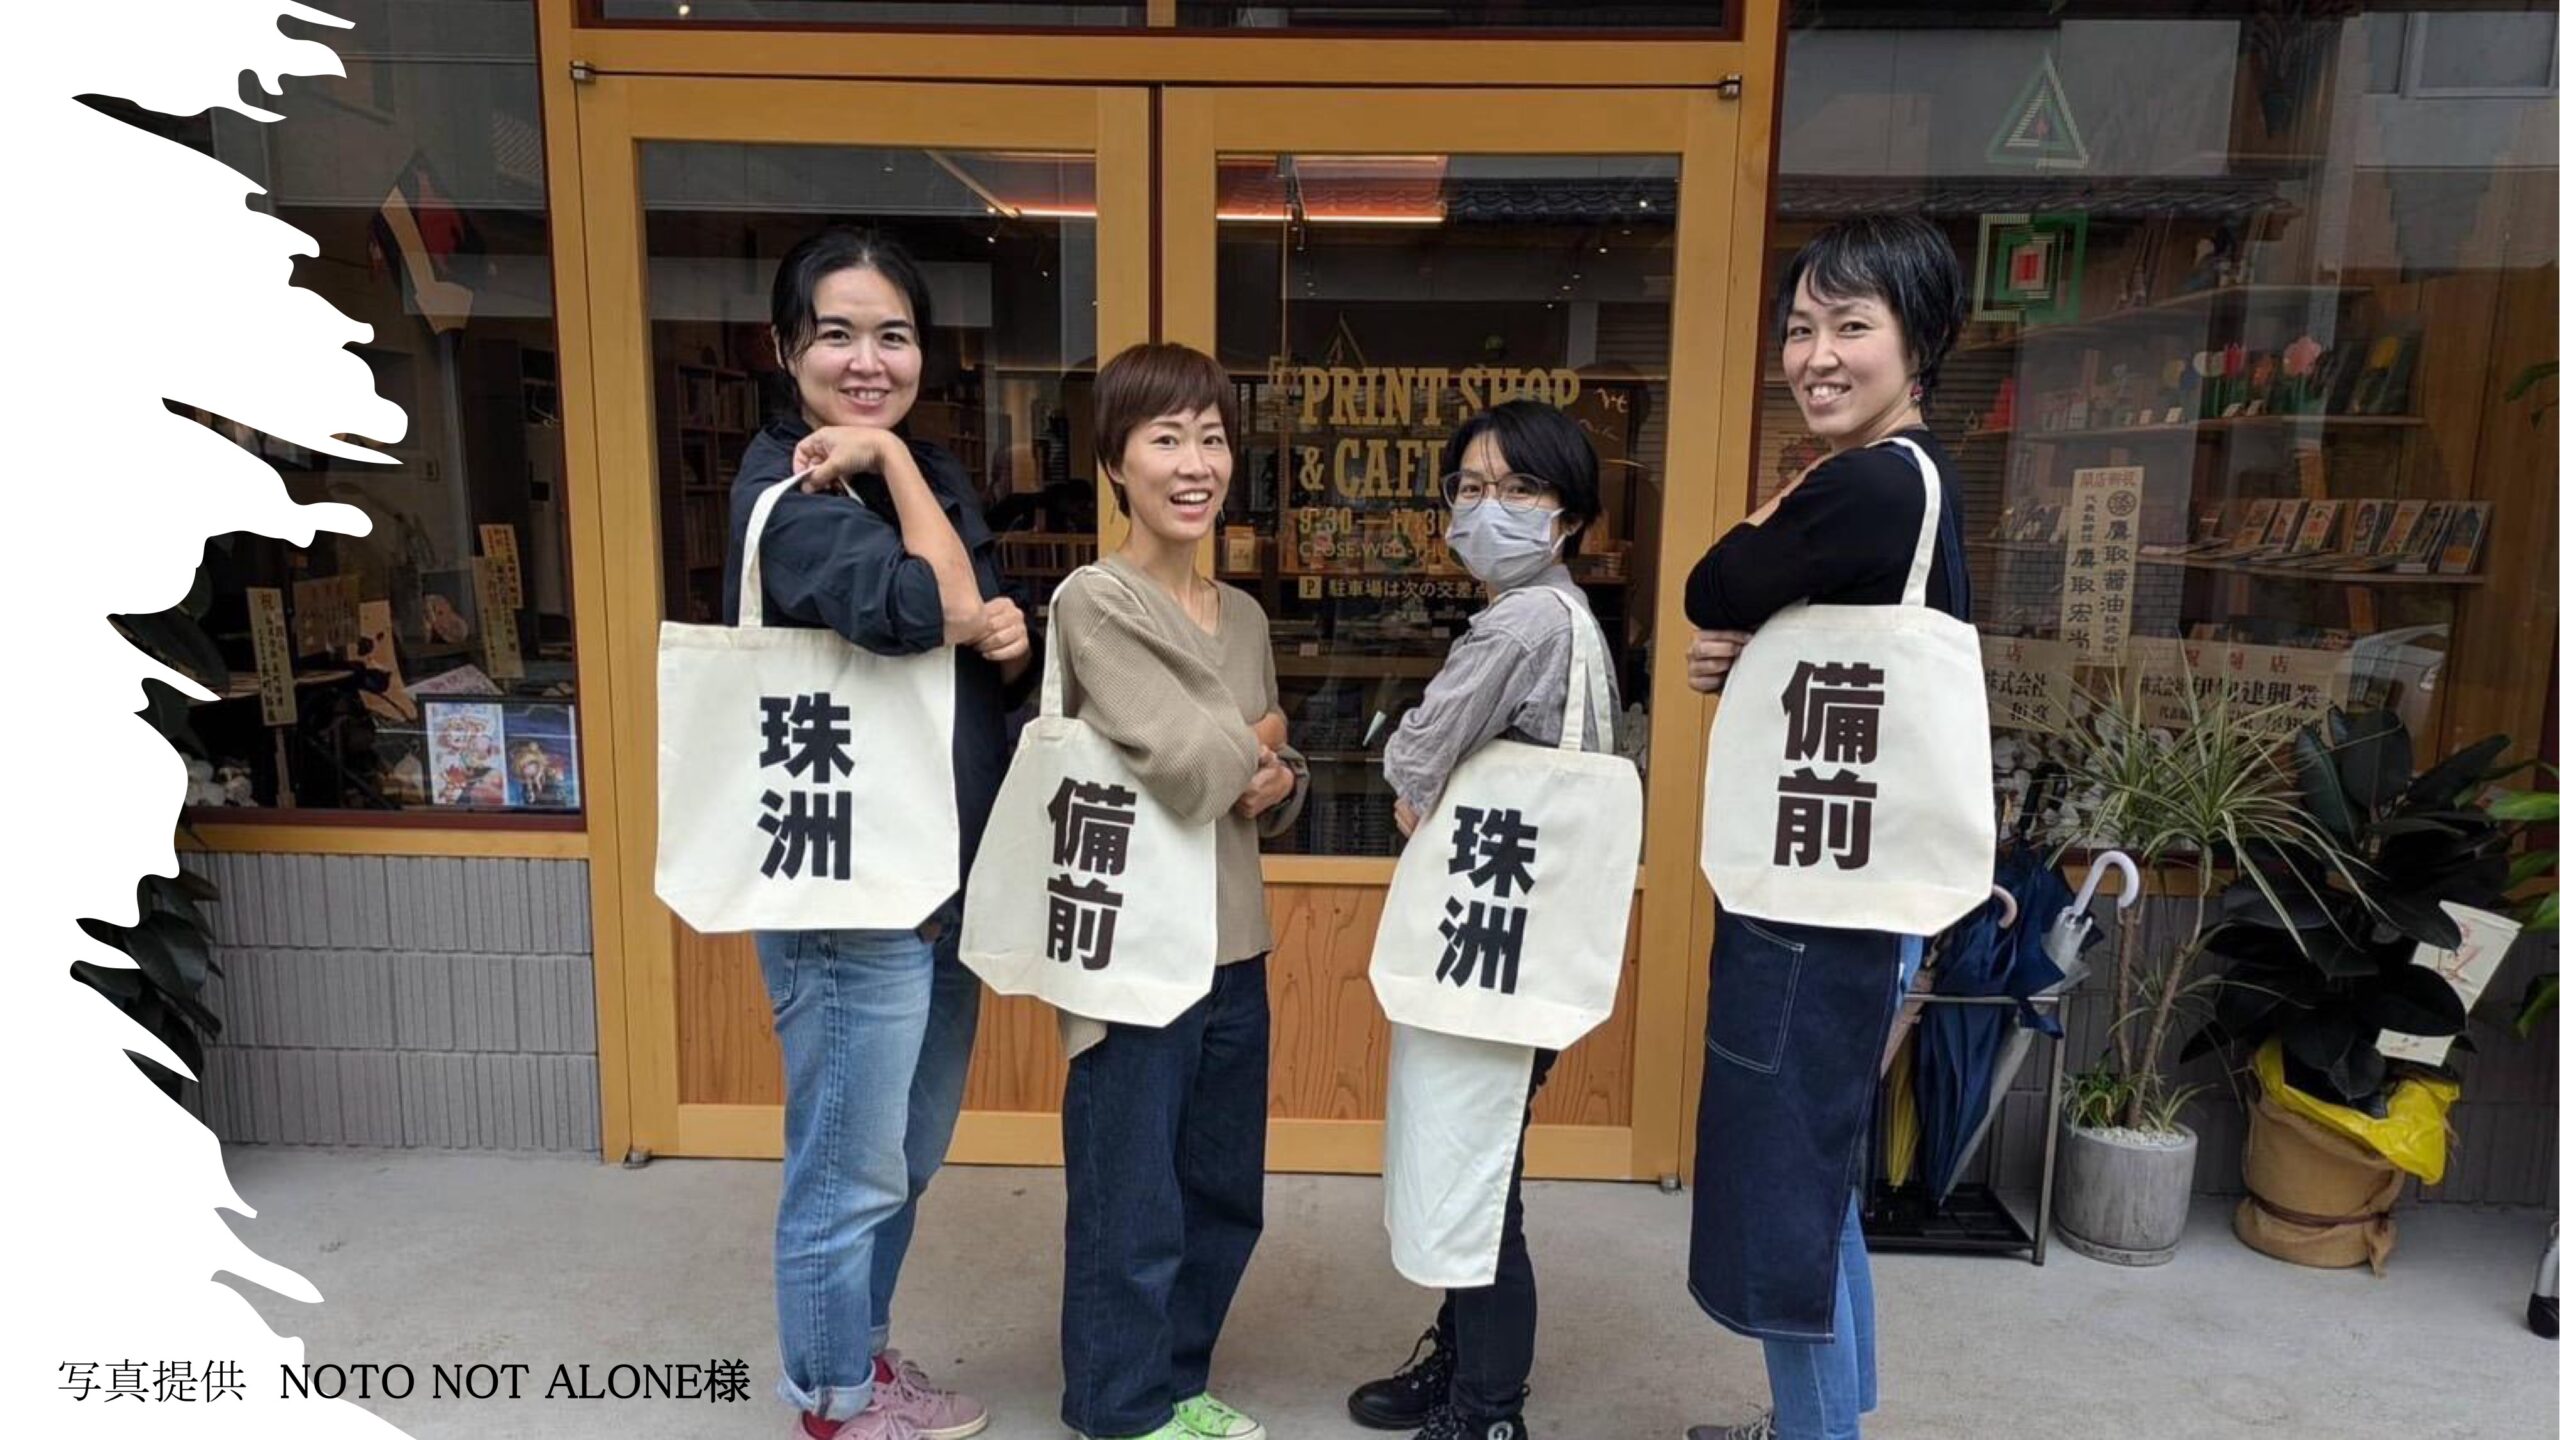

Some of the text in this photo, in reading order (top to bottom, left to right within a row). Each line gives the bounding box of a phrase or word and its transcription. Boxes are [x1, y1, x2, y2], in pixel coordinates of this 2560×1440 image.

[1299, 367, 1450, 426] PRINT
[1299, 446, 1325, 491] &
[757, 692, 855, 880] 珠洲
[1773, 660, 1885, 870] 備前
[1047, 777, 1137, 971] 備前
[1435, 804, 1539, 995] 珠洲
